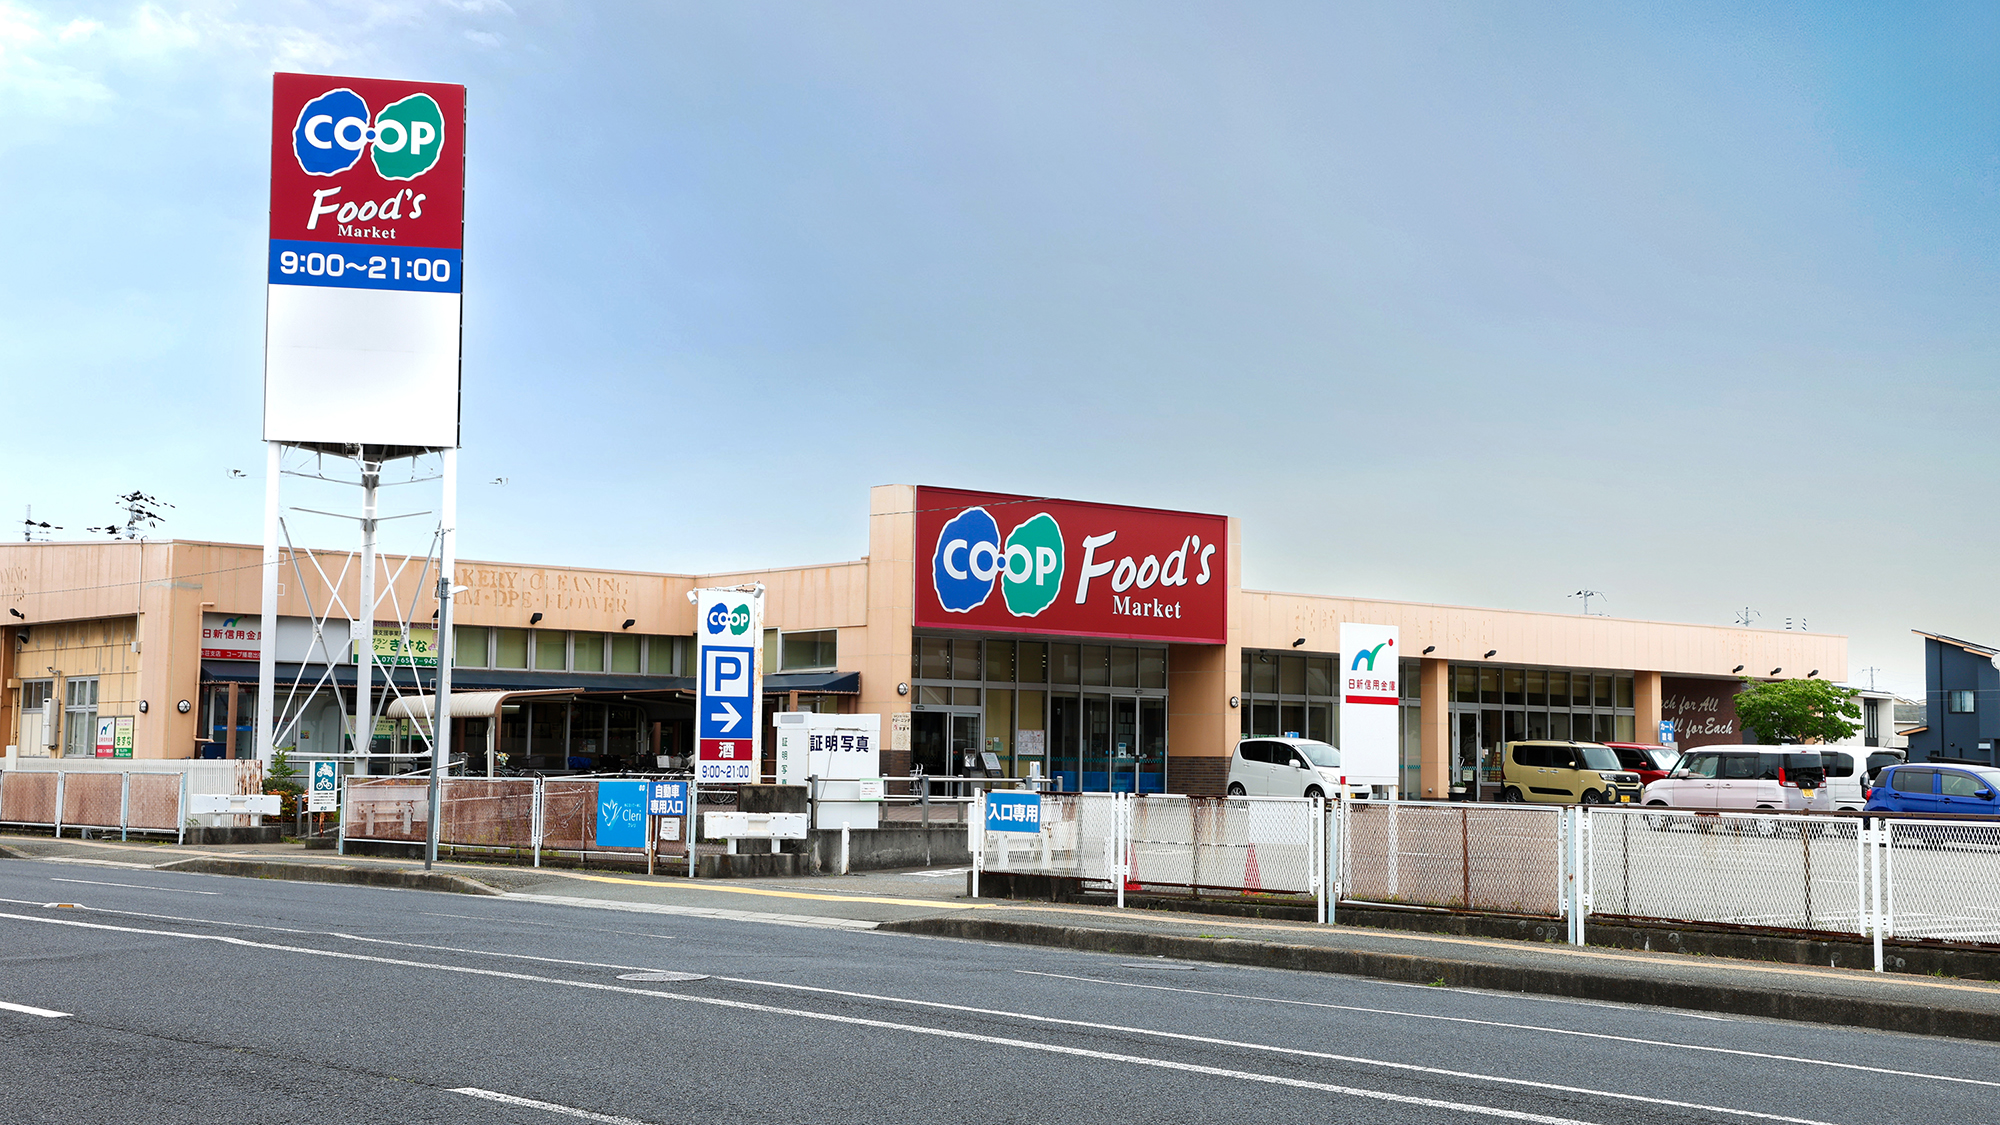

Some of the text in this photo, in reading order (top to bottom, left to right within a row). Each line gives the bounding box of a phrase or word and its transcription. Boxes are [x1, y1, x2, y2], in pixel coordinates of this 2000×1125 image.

[306, 186, 427, 230] Food's
[337, 224, 396, 239] Market
[1075, 530, 1216, 604] Food's
[434, 568, 518, 590] AKERY
[1112, 595, 1182, 619] Market
[715, 656, 742, 692] P
[1348, 678, 1396, 691] 日新信用金庫
[1697, 696, 1719, 713] All
[1685, 719, 1703, 739] for
[1704, 717, 1734, 735] Each
[718, 741, 735, 759] 酒
[809, 735, 870, 753] 証明写真
[655, 784, 680, 798] 自動車
[622, 808, 642, 821] Cleri
[650, 799, 684, 814] 専用入口
[988, 803, 1039, 823] 入口専用
